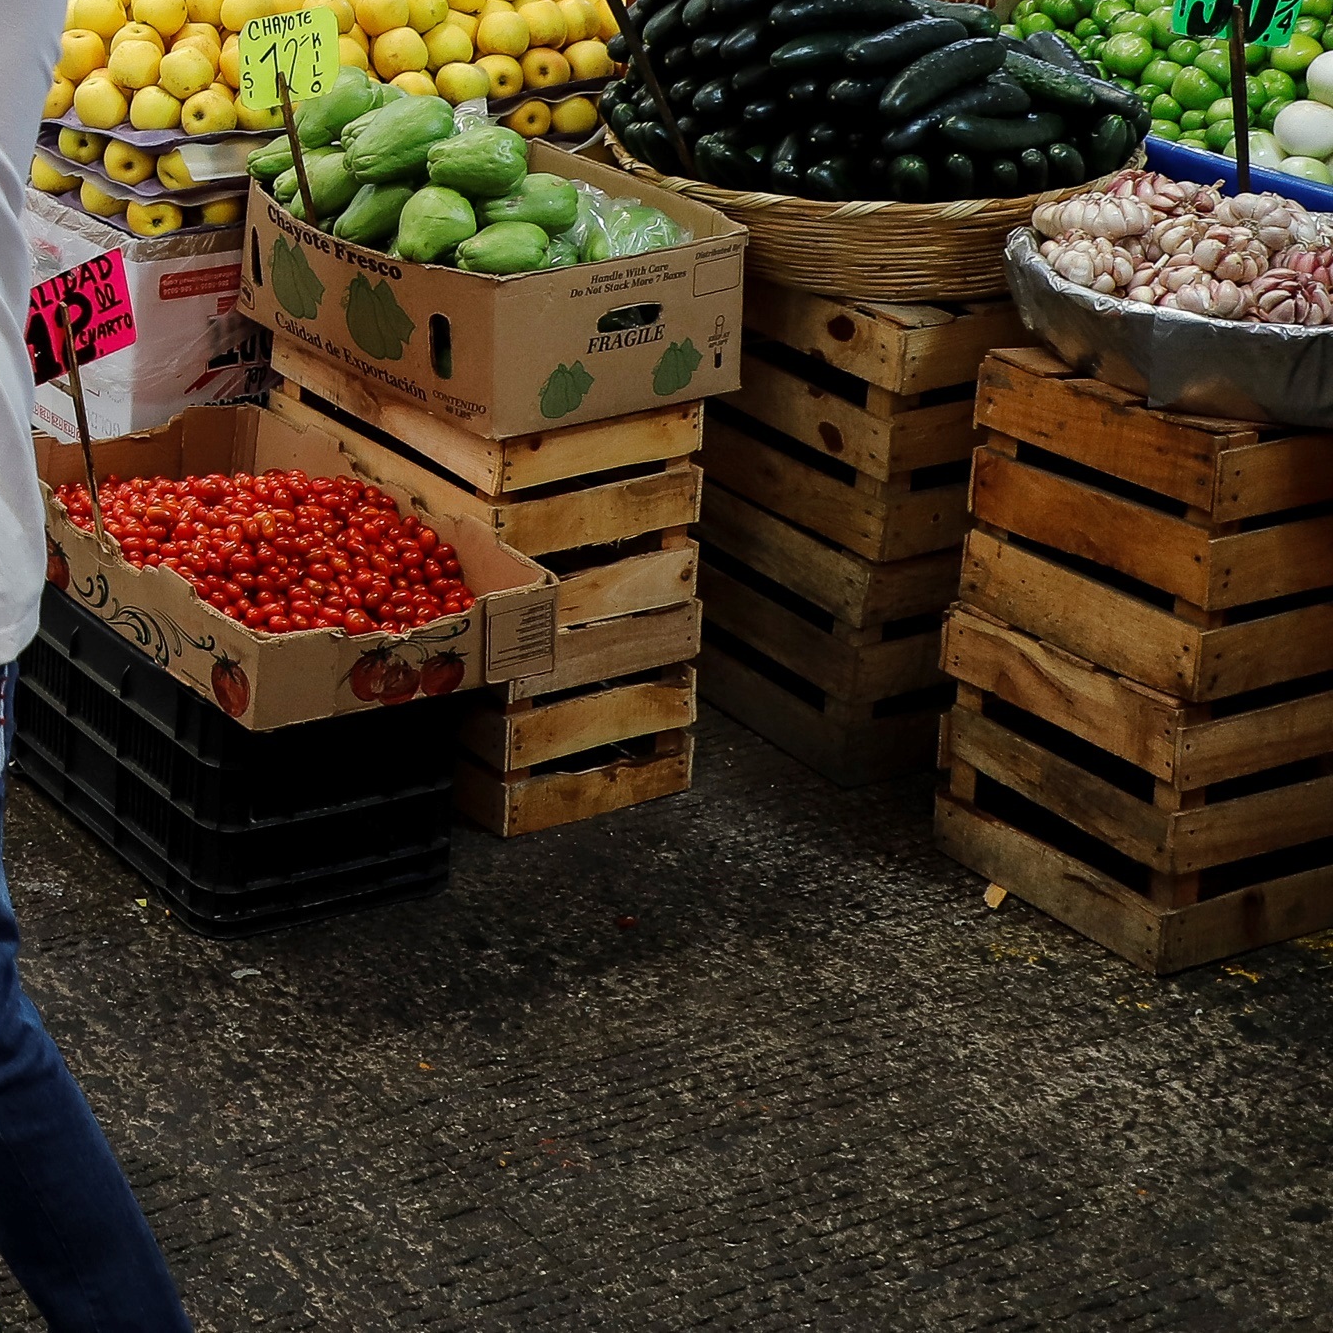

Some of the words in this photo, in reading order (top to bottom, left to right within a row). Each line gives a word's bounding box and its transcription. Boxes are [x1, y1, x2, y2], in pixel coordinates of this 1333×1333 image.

[248, 10, 312, 41] CHAYOTE
[311, 32, 323, 93] KILO
[267, 204, 331, 254] Chayote
[333, 244, 403, 280] Fresco
[695, 246, 731, 260] Distributed
[569, 288, 583, 298] Do
[585, 284, 602, 296] Not
[604, 280, 629, 294] Stack
[631, 278, 654, 288] More
[655, 275, 661, 284] 7
[663, 270, 687, 282] Boxes
[590, 270, 624, 284] Handle
[625, 266, 647, 278] With
[648, 264, 669, 274] Care
[79, 312, 133, 346] CUARTO
[586, 324, 665, 354] FRAGILE
[275, 312, 324, 350] Calidad
[325, 340, 341, 360] de
[343, 350, 427, 402] Exportación
[433, 390, 487, 414] CONTENIDO
